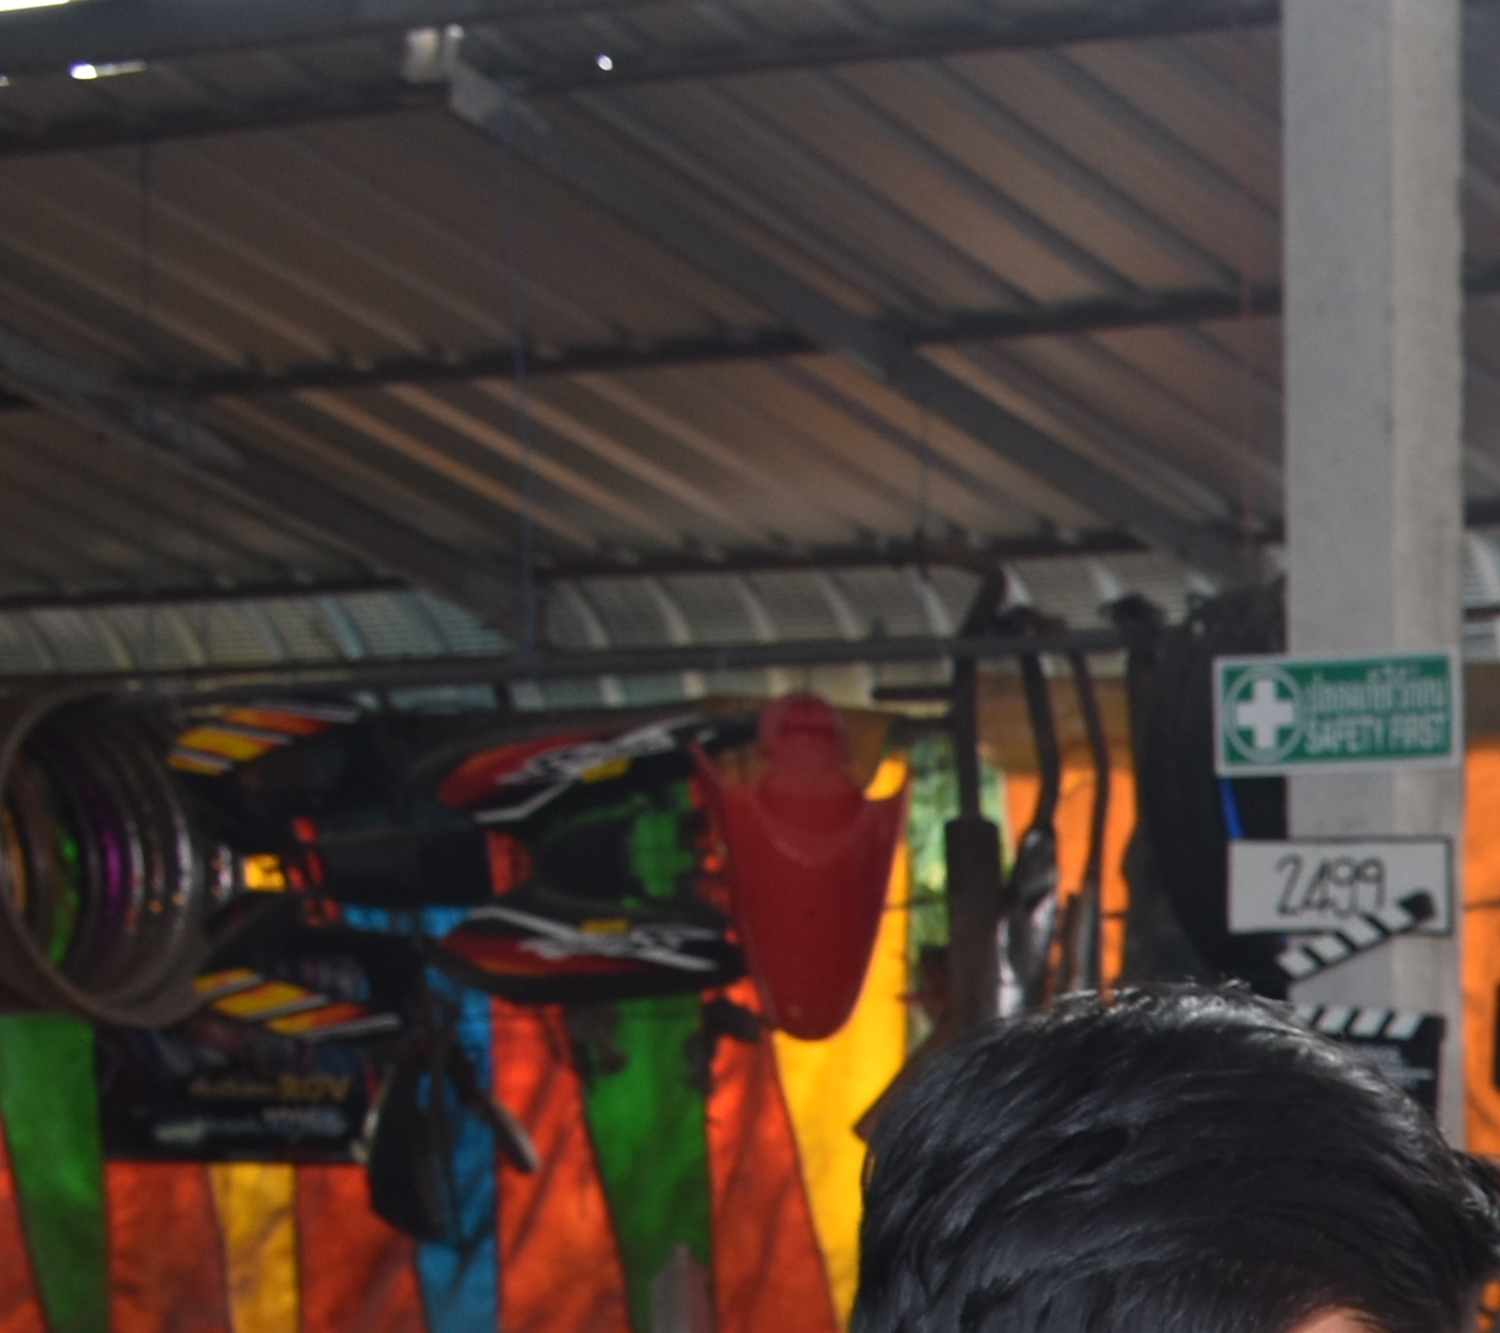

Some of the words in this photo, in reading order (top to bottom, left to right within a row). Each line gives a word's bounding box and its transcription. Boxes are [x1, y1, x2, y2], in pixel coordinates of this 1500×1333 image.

[1305, 716, 1384, 754] SAFETY
[1389, 711, 1446, 750] FIRST
[1273, 852, 1387, 917] 2499
